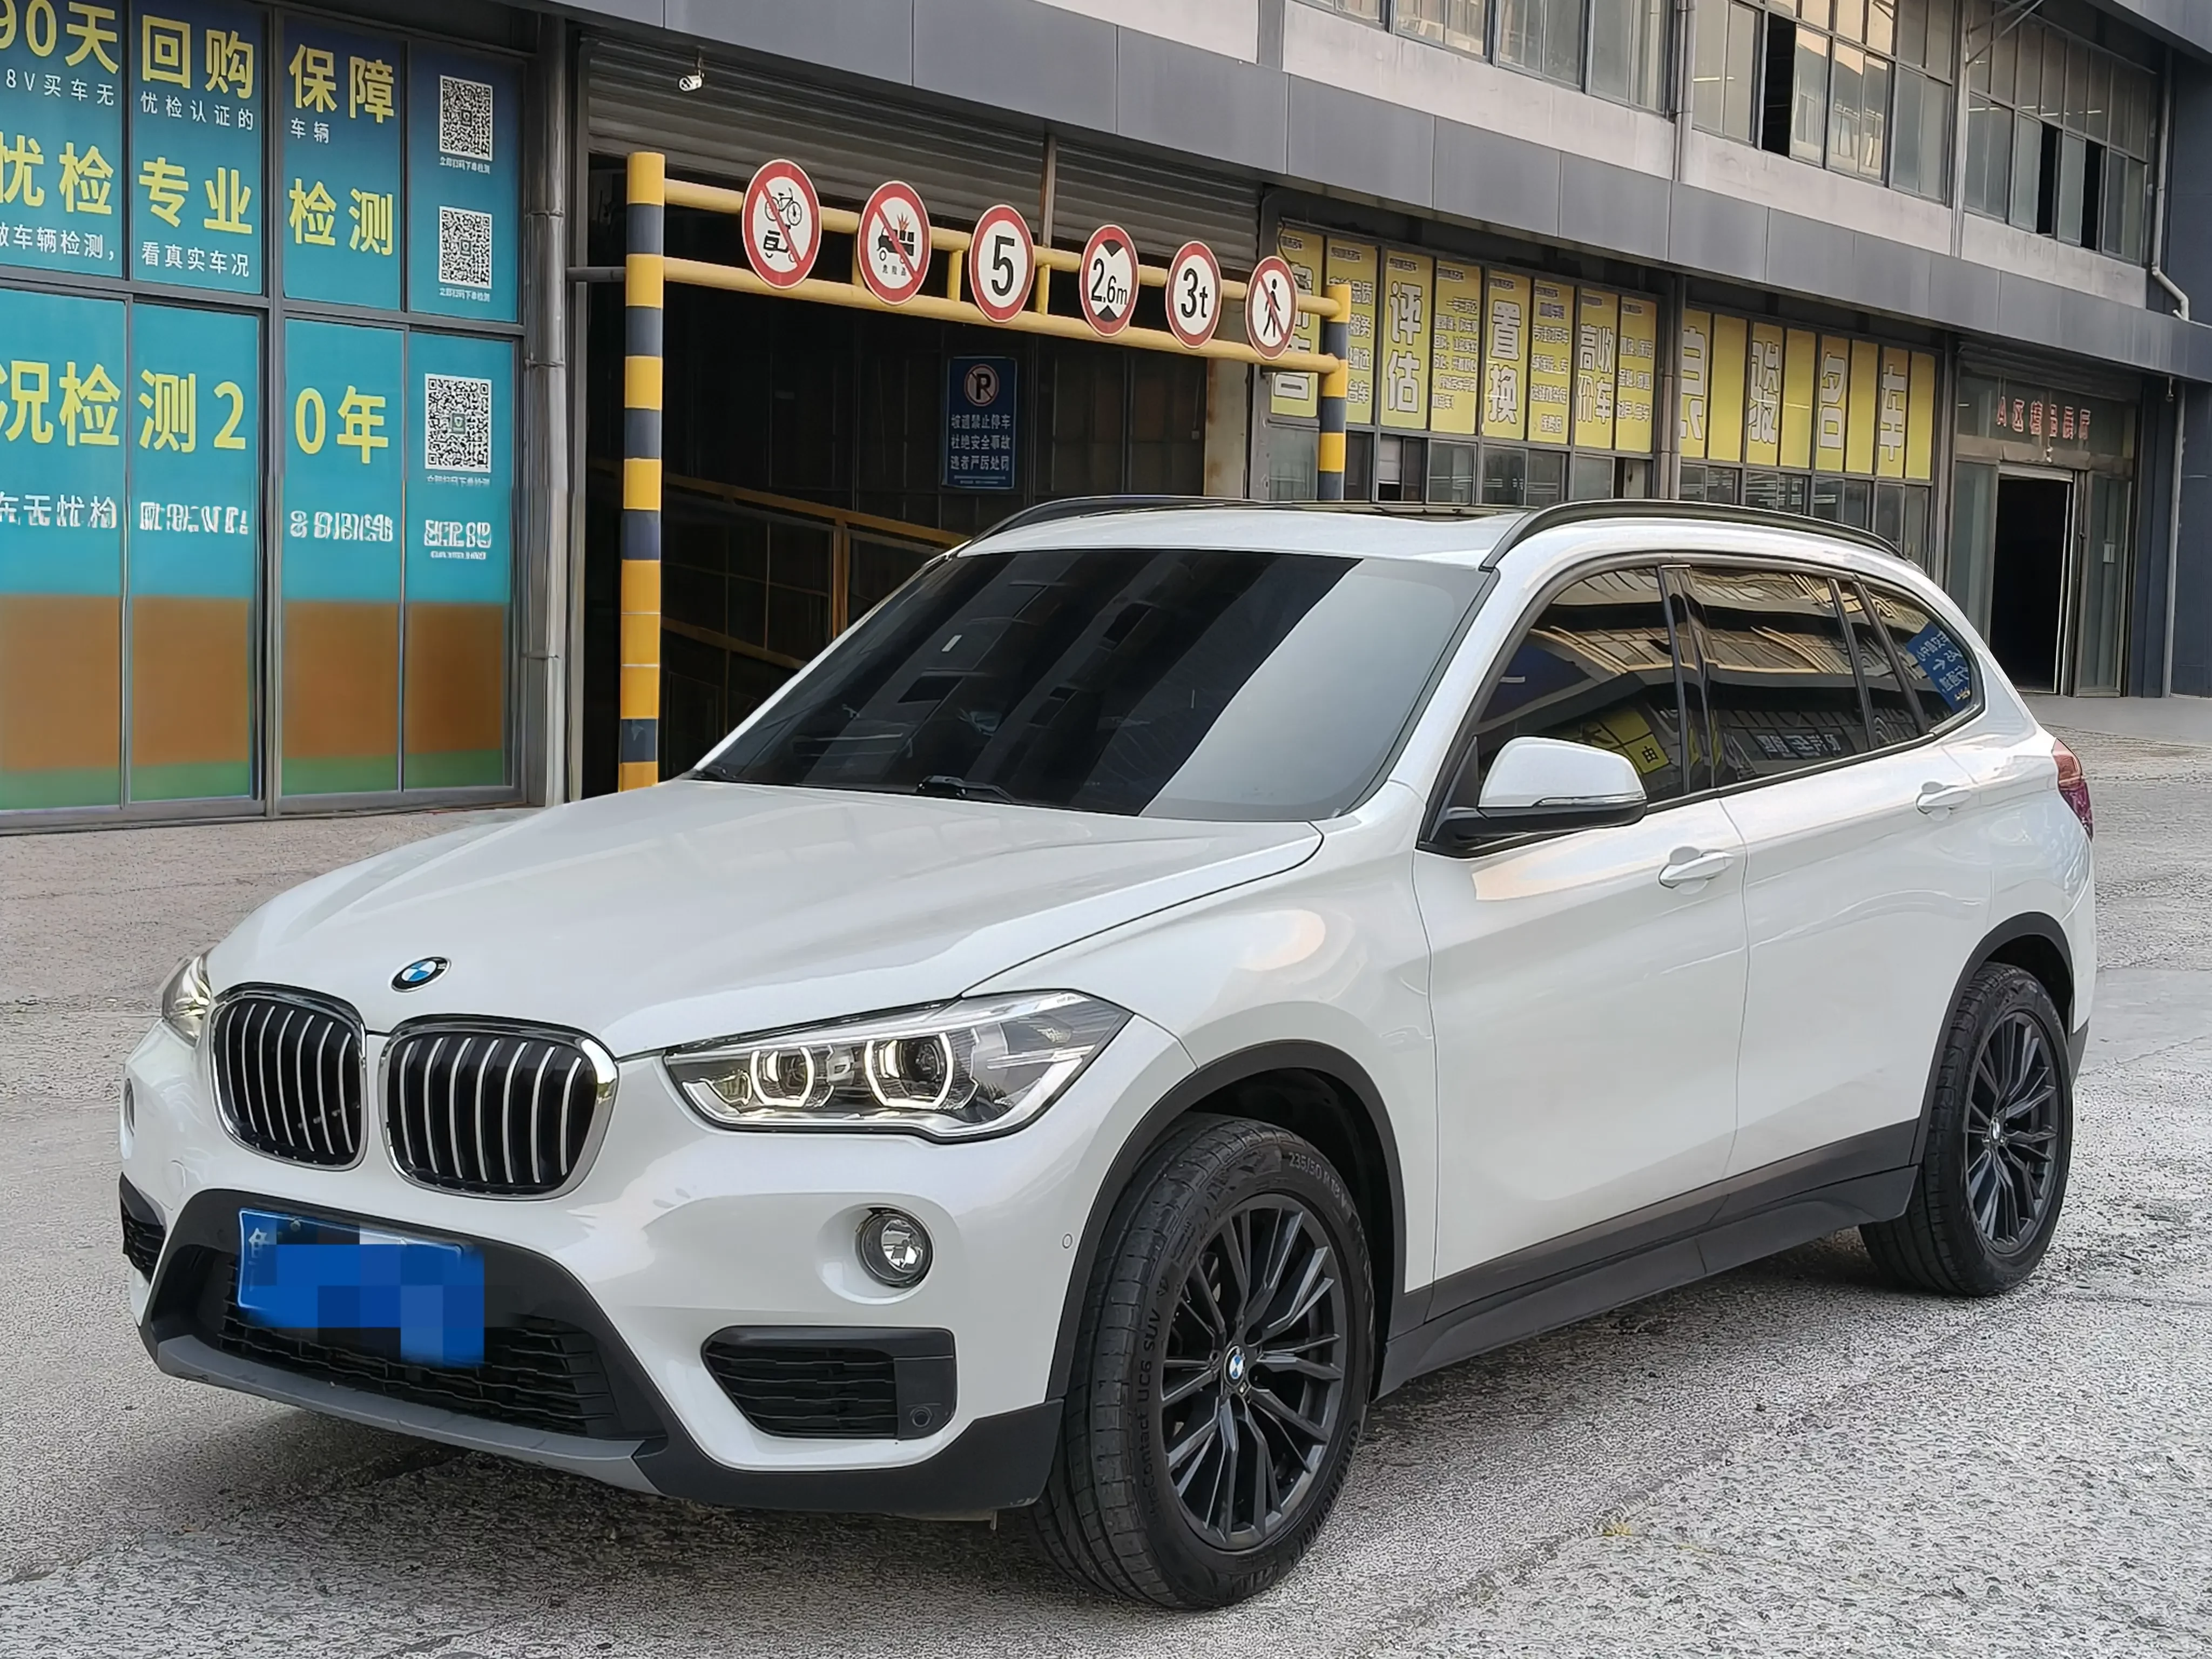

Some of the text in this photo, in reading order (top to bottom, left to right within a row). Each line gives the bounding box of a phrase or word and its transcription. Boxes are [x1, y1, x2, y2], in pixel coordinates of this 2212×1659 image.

[141, 15, 254, 99] 回购
[288, 44, 395, 124] 保障
[138, 157, 253, 234] 专业
[288, 178, 394, 255] 检测
[991, 234, 1015, 296] 5
[1091, 258, 1128, 306] 2.6m
[1181, 267, 1209, 319] 3t
[1142, 1307, 1161, 1351] SUV
[1137, 1360, 1152, 1403] UC6
